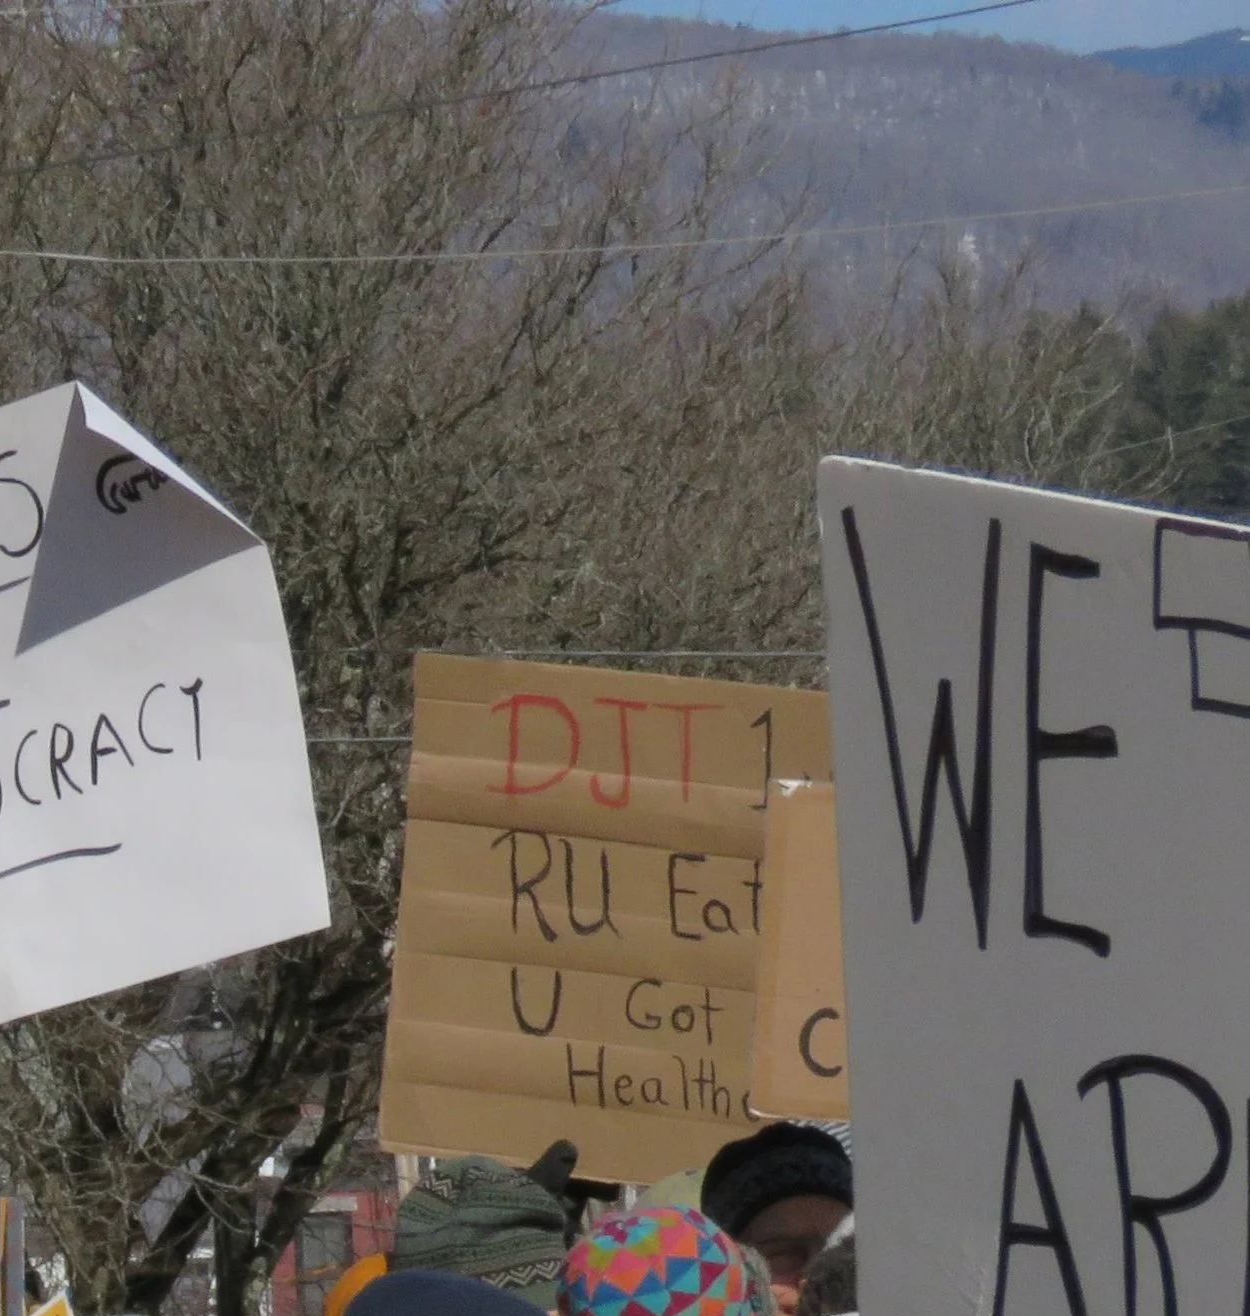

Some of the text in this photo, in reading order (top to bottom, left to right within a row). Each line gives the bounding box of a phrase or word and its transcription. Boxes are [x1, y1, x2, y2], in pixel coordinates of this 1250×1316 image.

[485, 693, 724, 808] DJT
[840, 505, 1120, 958] WE
[510, 967, 725, 1045] U Got
